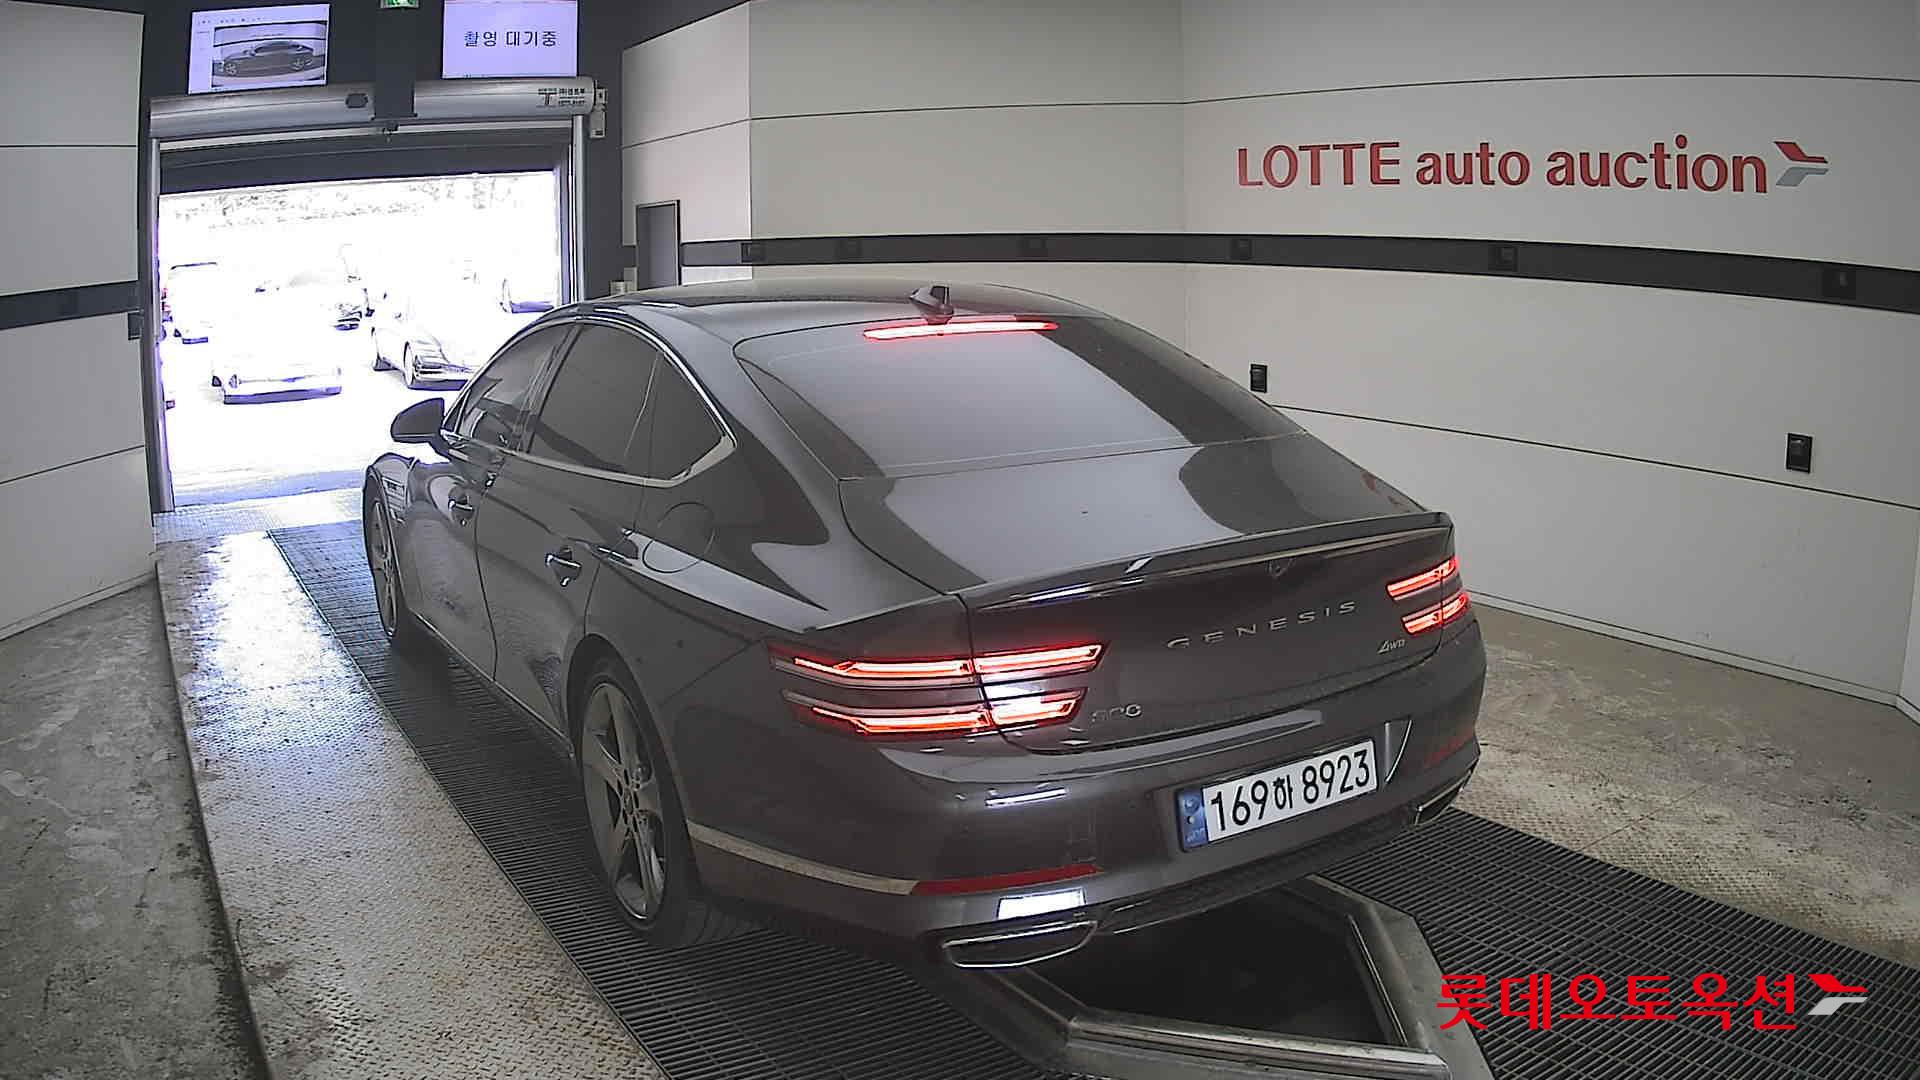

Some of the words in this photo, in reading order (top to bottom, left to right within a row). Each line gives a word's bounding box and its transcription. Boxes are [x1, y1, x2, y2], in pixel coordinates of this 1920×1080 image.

[506, 31, 557, 47] 대기중
[1238, 142, 1400, 187] LOTTE
[1416, 142, 1530, 186] auto
[1546, 134, 1767, 193] auction
[1167, 601, 1356, 649] GENESIS
[1210, 774, 1293, 831] 169하
[1302, 749, 1370, 804] 8923
